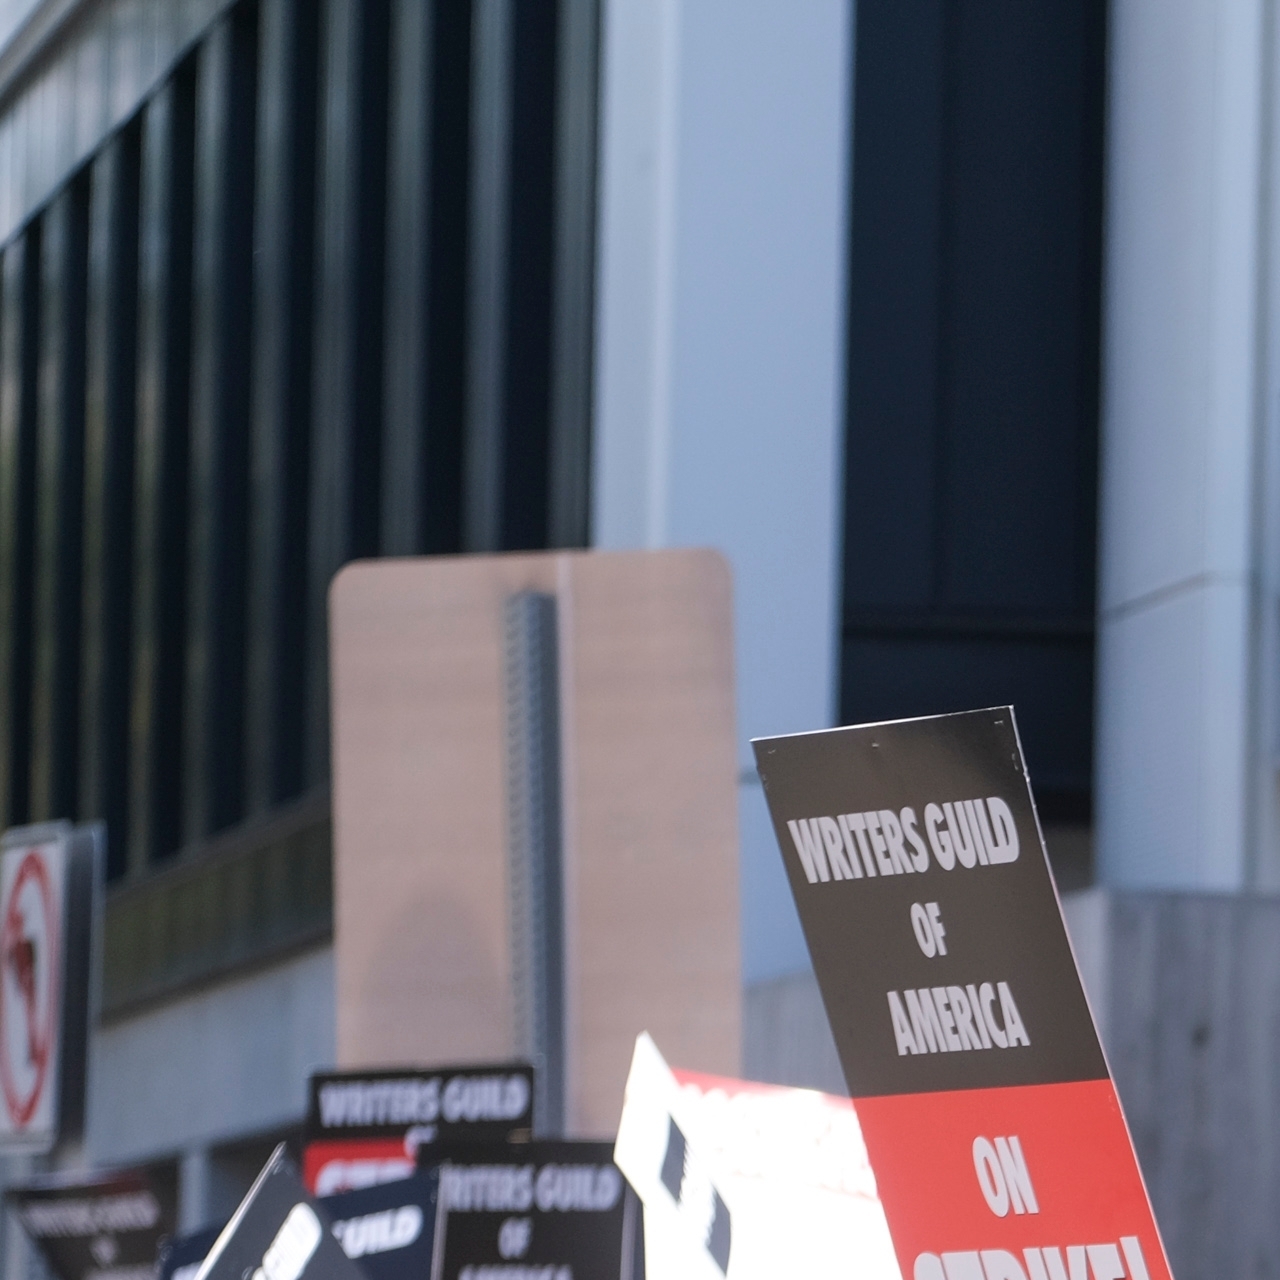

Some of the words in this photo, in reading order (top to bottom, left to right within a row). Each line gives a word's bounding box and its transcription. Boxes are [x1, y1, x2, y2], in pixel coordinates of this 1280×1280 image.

[787, 806, 931, 884] WRITERS
[926, 796, 1020, 872] GUILD
[910, 901, 948, 959] OF
[887, 981, 1031, 1057] AMERICA
[441, 1073, 530, 1123] GUILD
[441, 1164, 534, 1213] RITERS
[534, 1162, 624, 1213] GUILD
[971, 1134, 1039, 1218] ON
